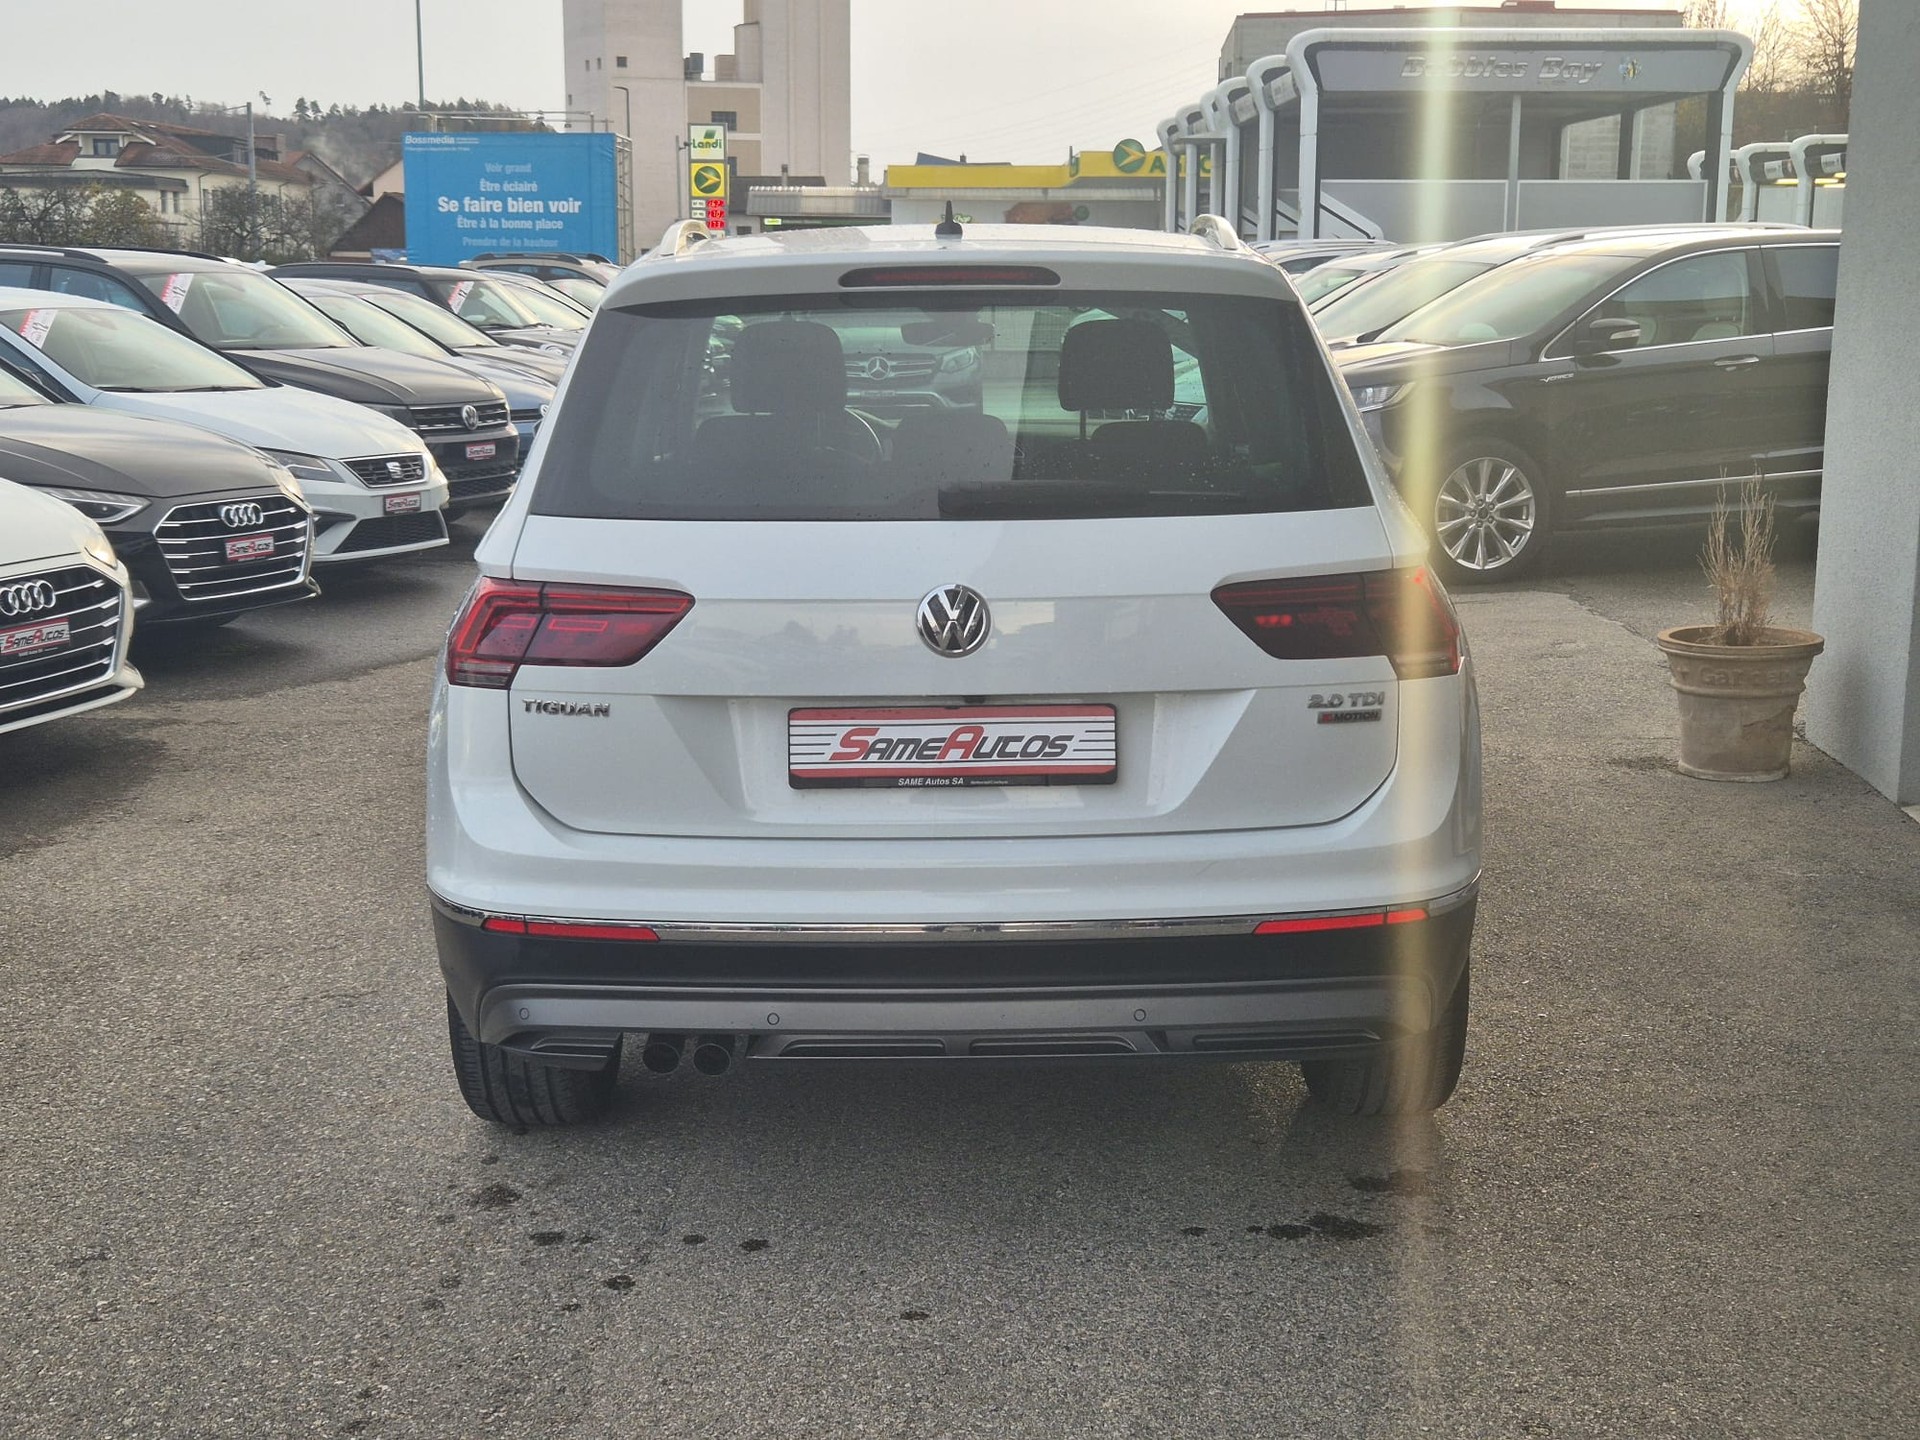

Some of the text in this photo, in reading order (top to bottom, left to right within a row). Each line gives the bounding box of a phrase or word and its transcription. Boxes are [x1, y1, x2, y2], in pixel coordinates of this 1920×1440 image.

[1538, 56, 1603, 84] Bay
[480, 178, 501, 192] Être
[438, 196, 582, 213] Se faire bien voir
[457, 214, 564, 231] Être à la bonne place
[522, 699, 610, 717] TIGUAN
[1307, 691, 1385, 709] 2.0 TDI
[898, 777, 924, 786] SAME
[925, 777, 950, 786] Autos
[952, 777, 964, 785] SA
